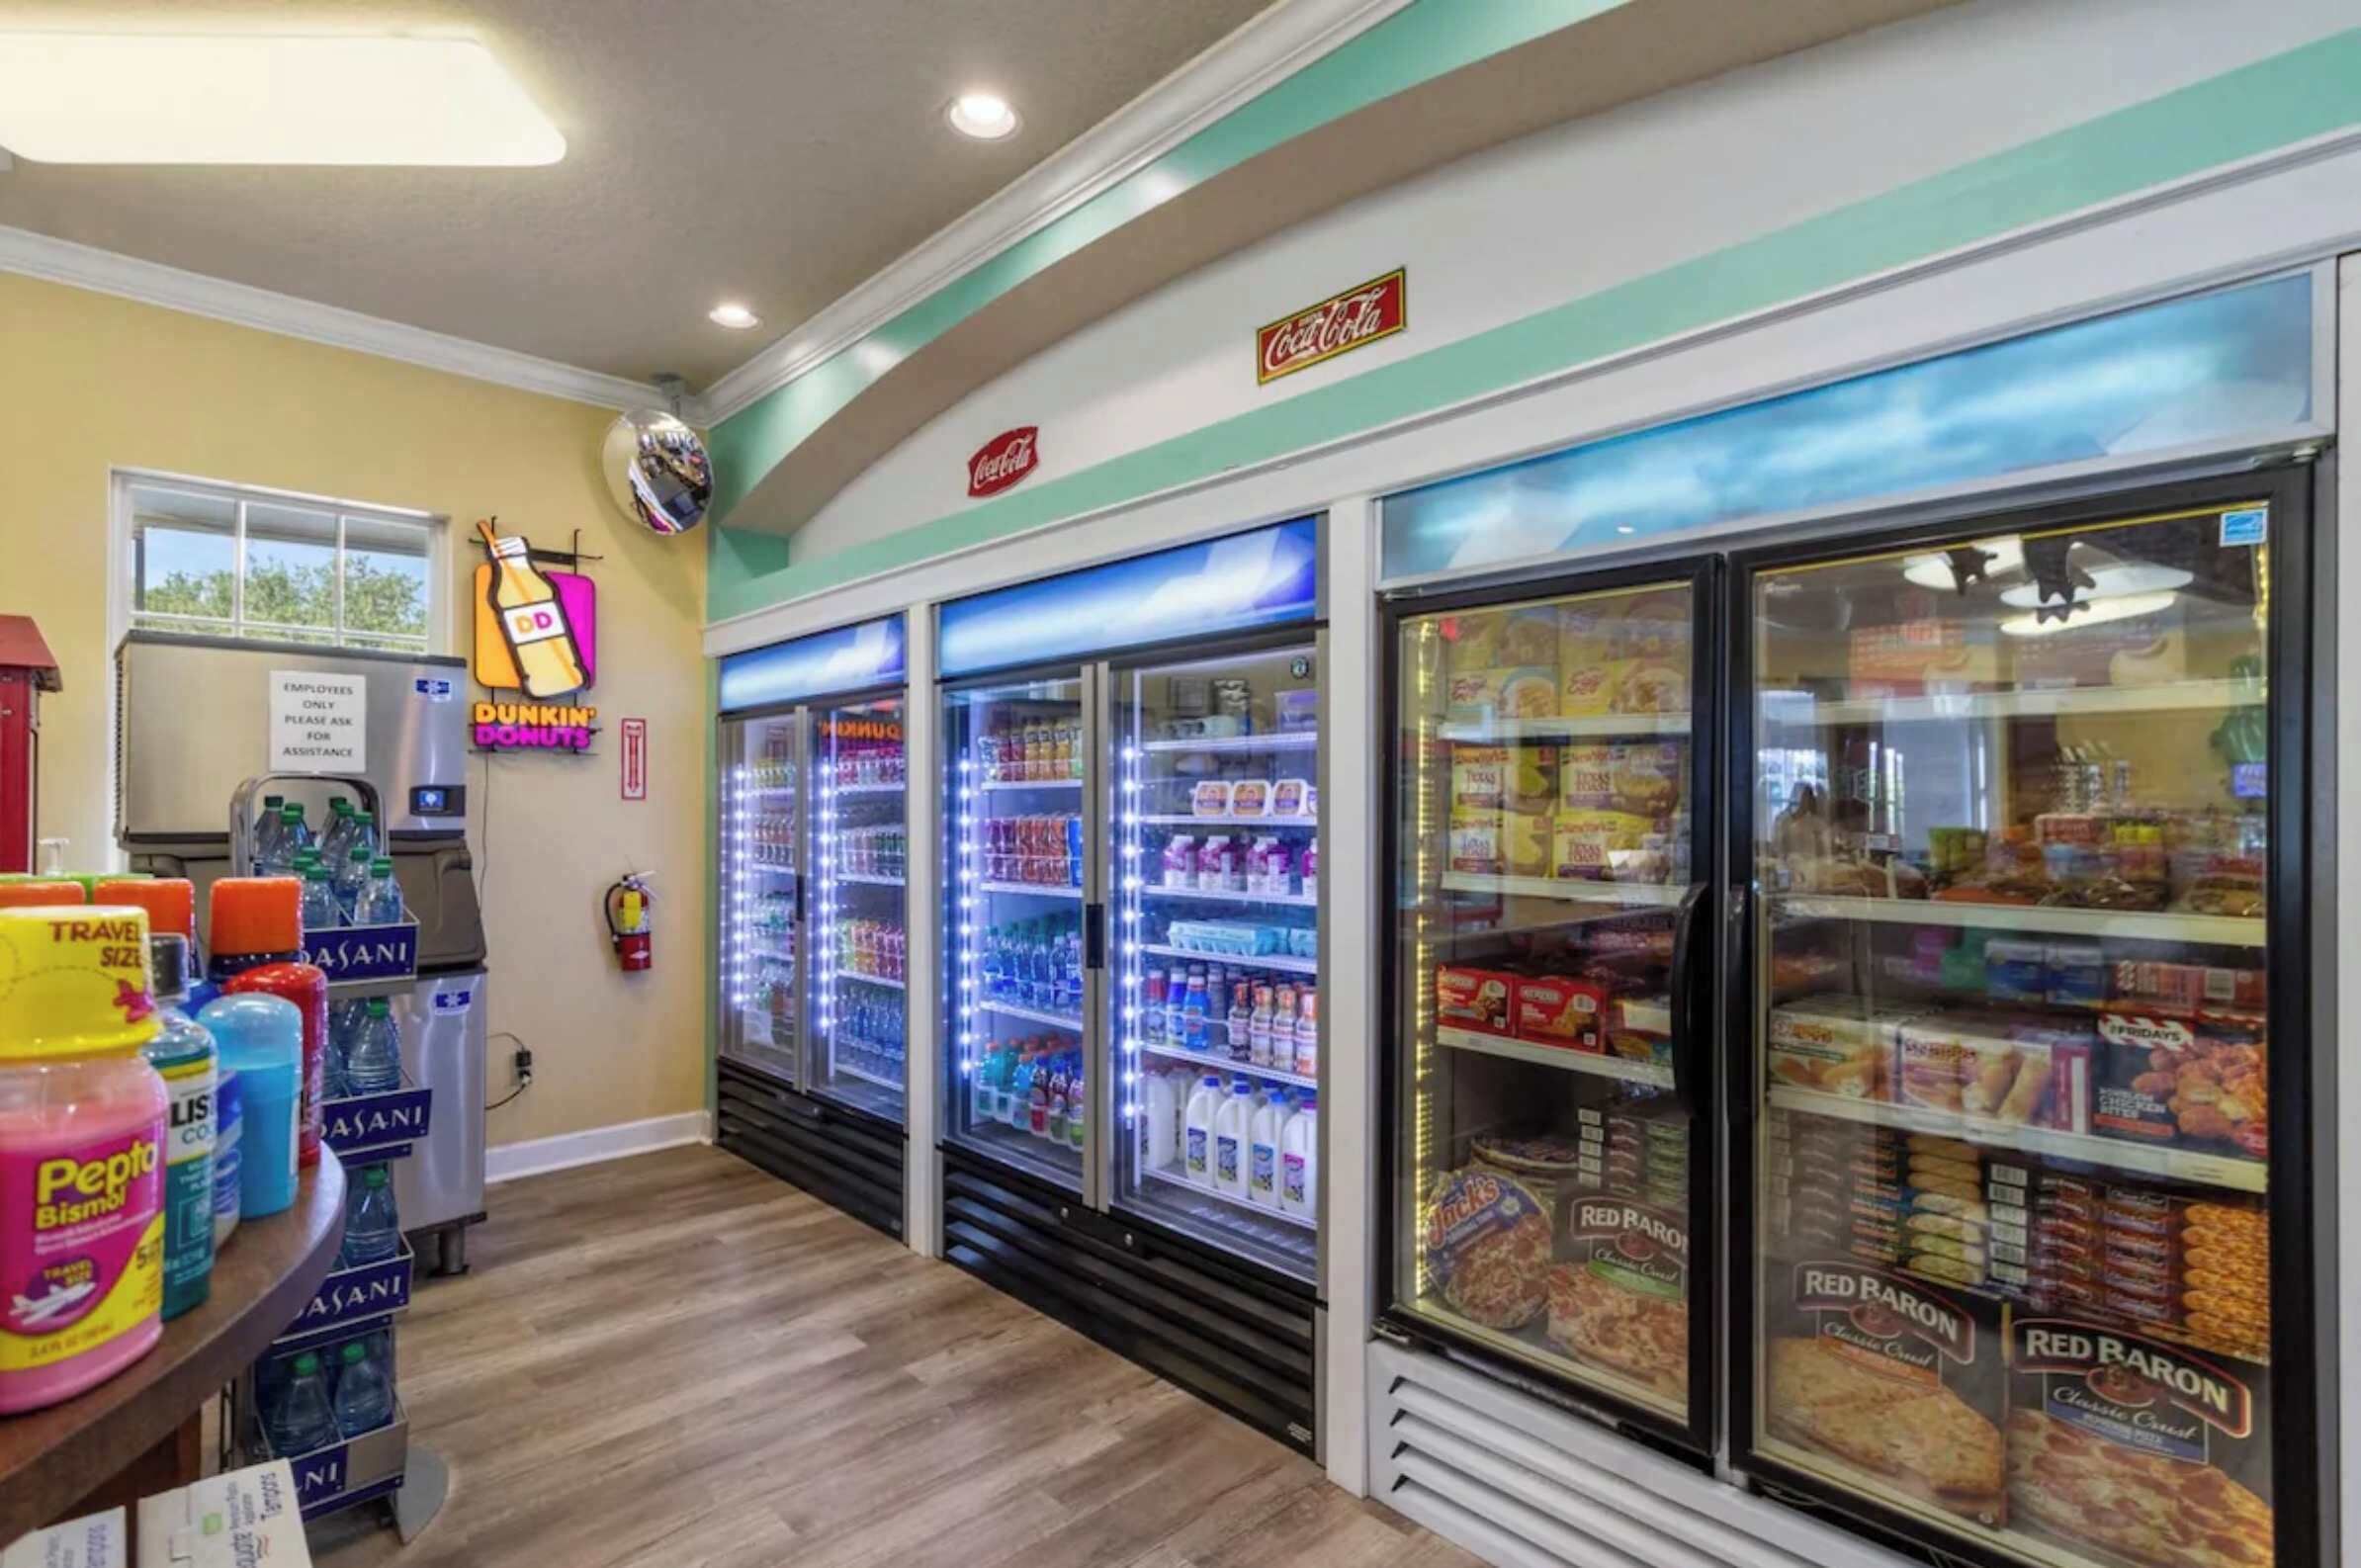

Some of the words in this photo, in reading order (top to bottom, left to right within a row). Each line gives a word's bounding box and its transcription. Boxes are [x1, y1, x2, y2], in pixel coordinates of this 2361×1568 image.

[283, 682, 354, 695] EMPLOYEES
[303, 700, 336, 710] ONLY
[284, 715, 327, 726] PLEASE
[330, 717, 353, 727] ASK
[475, 703, 597, 728] DUNKIN'
[283, 746, 353, 757] ASSISTANCE
[306, 731, 332, 741] FOR
[475, 724, 591, 749] DONUTS
[170, 1093, 215, 1128] LIS
[321, 1105, 422, 1138] ASANI
[37, 1139, 158, 1205] Pepto
[36, 1185, 127, 1230] Bismol
[1581, 1205, 1620, 1227] RED
[298, 1275, 401, 1318] ASANI
[1805, 1270, 1856, 1297] RED
[1859, 1274, 1958, 1343] BARON
[1823, 1321, 1880, 1350] Classic
[1882, 1340, 1934, 1366] Crust
[2027, 1329, 2092, 1359] RED
[2097, 1336, 2229, 1414] BARON
[2053, 1386, 2129, 1421] Classic
[2133, 1410, 2198, 1440] Crust
